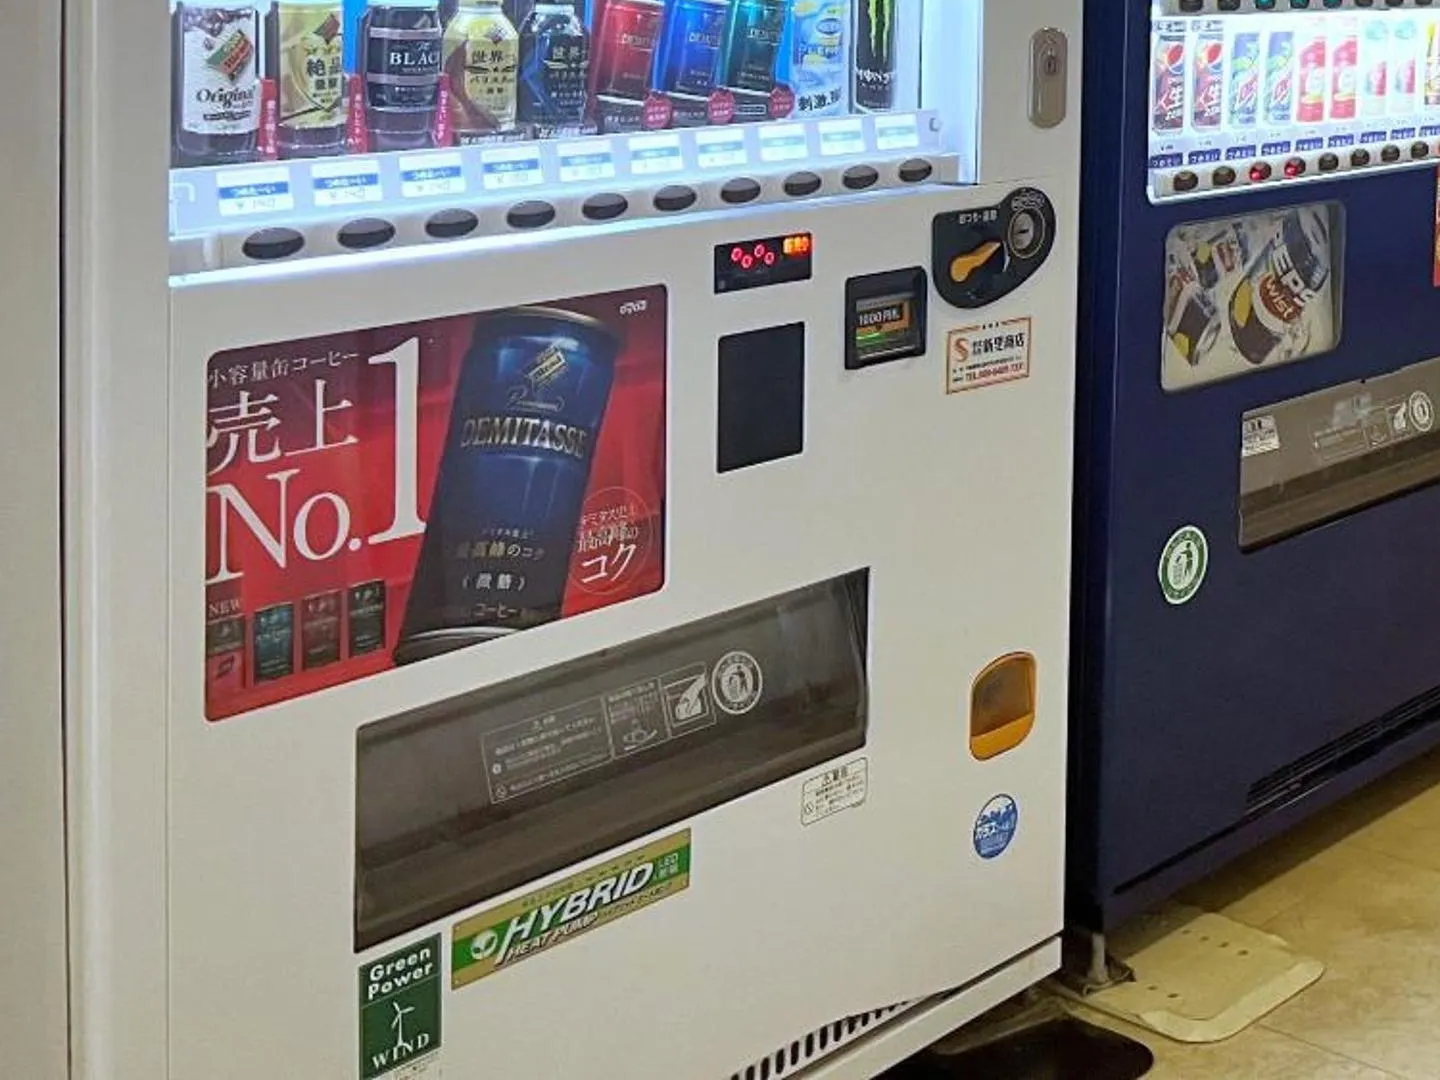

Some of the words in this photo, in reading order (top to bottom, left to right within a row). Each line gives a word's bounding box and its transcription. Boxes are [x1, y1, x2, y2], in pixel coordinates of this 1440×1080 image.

[208, 350, 359, 390] 小容量缶コーヒー
[206, 378, 360, 477] 売上
[460, 417, 588, 459] DEMITASSE
[581, 544, 637, 584] コク
[494, 862, 654, 967] HYBRID
[367, 961, 433, 1001] Power
[369, 948, 431, 981] Green
[372, 1033, 430, 1070] WIND
